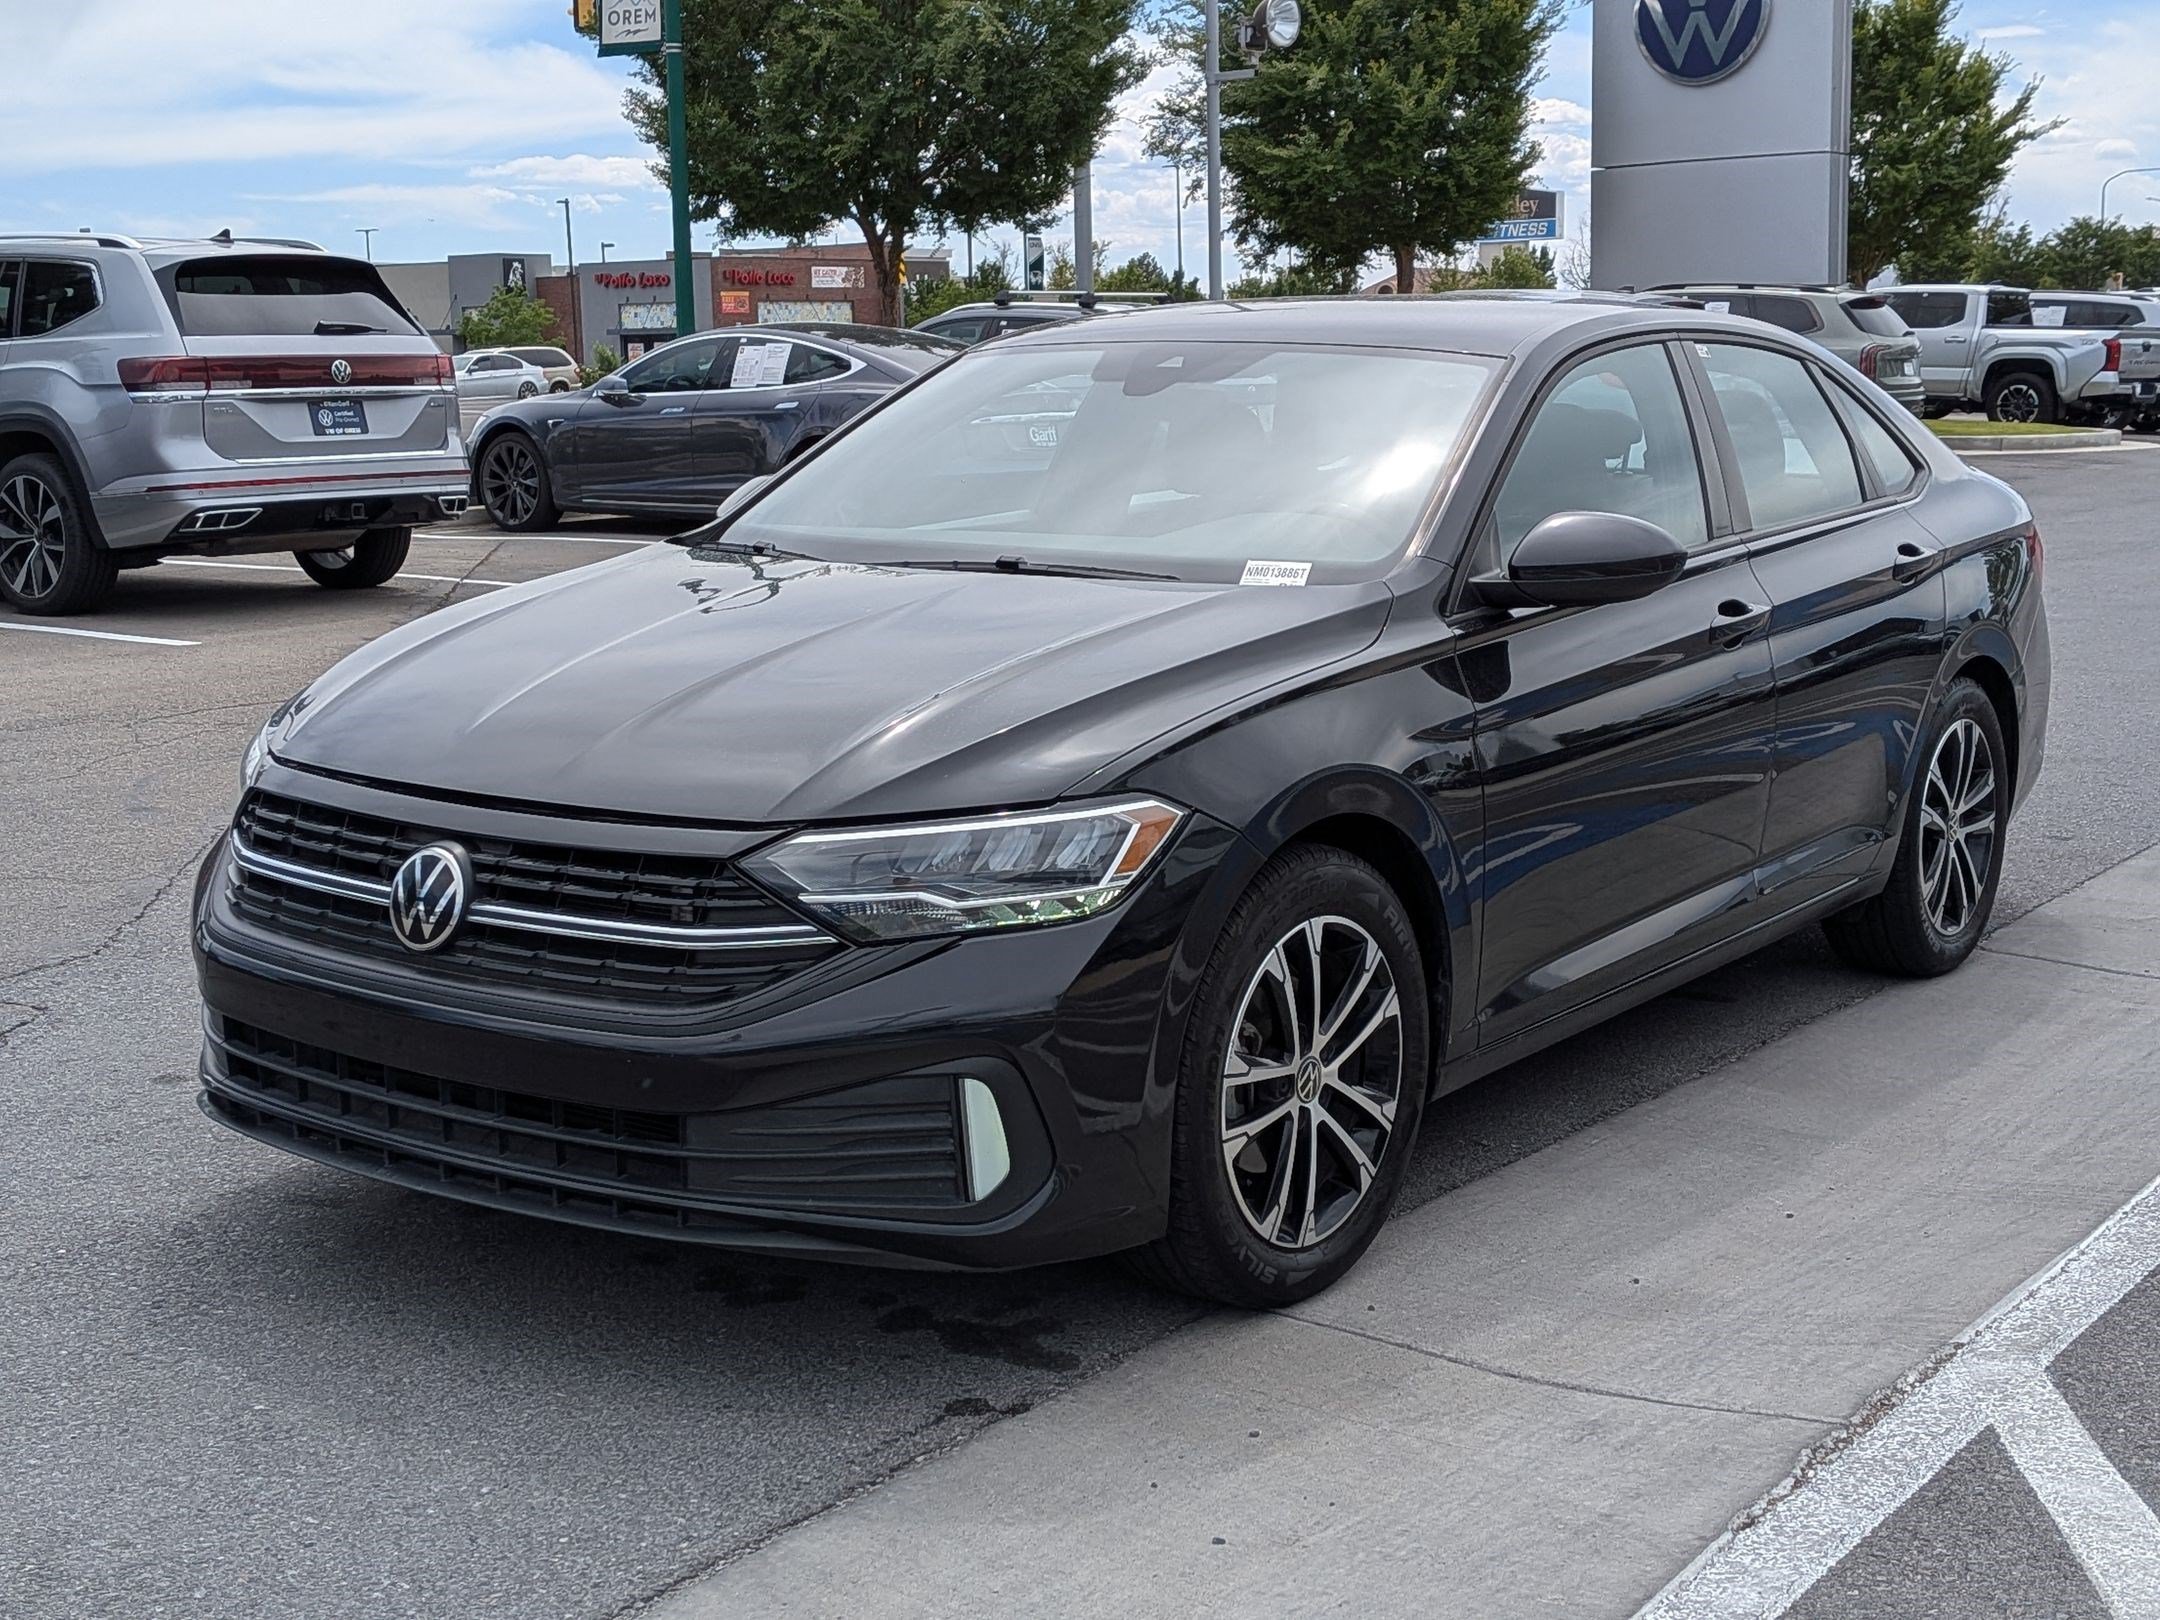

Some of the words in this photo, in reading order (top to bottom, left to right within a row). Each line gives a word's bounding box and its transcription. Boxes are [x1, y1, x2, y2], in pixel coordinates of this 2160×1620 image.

[608, 8, 656, 26] OREM
[602, 272, 636, 289] Pollo
[639, 272, 671, 289] Loco
[734, 269, 765, 286] Pollo
[767, 270, 797, 286] Loco
